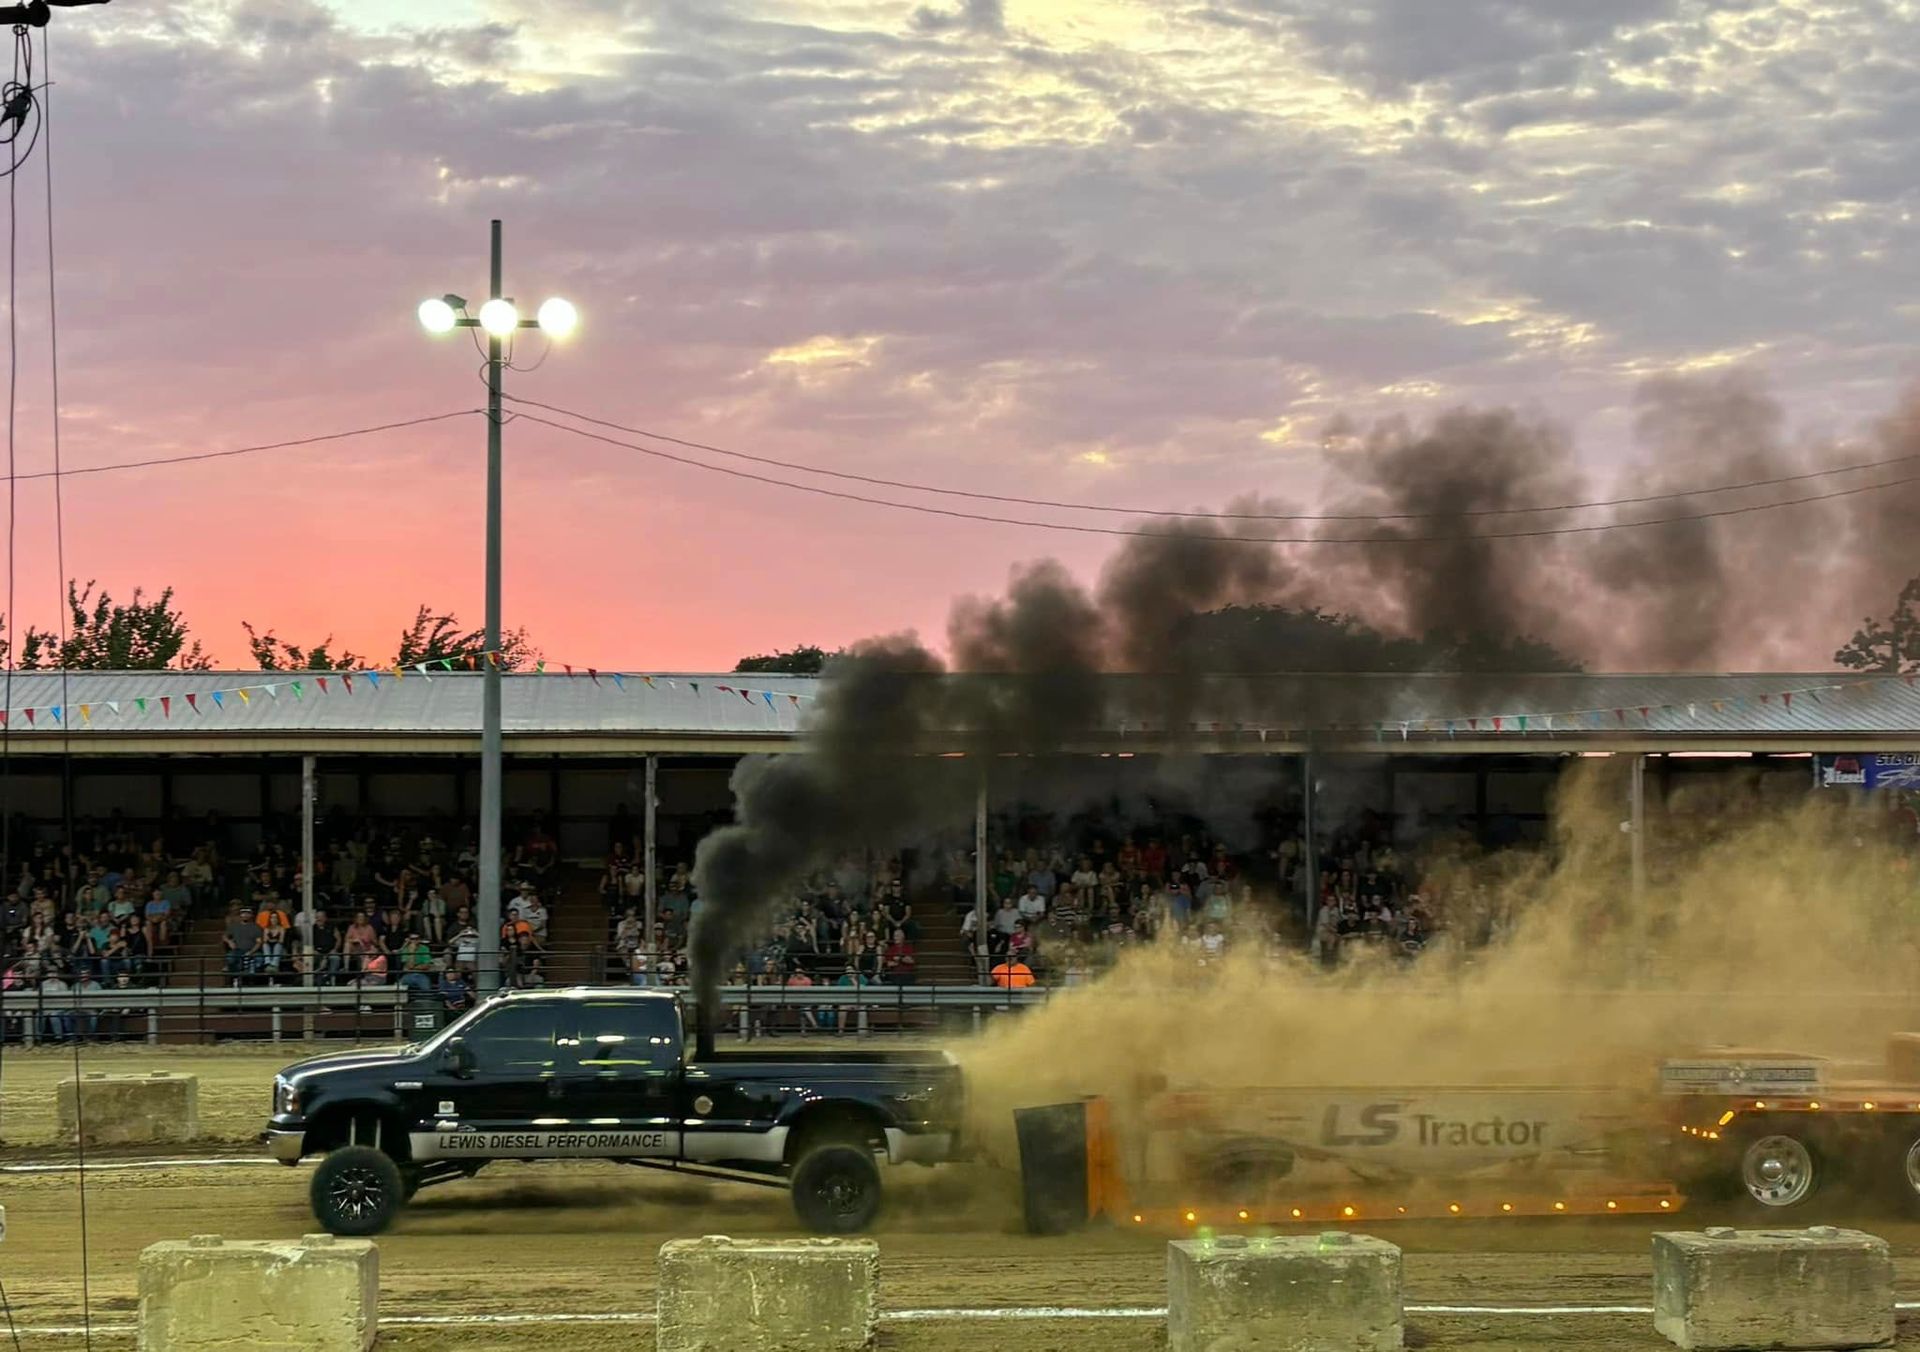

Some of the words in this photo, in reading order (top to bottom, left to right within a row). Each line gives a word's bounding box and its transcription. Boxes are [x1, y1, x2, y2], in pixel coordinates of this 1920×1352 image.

[1320, 1103, 1400, 1146] LS
[1412, 1113, 1549, 1146] Tractor
[440, 1135, 486, 1149] LEWIS
[490, 1135, 543, 1149] DIESEL
[547, 1134, 662, 1148] PERFORMANCE
